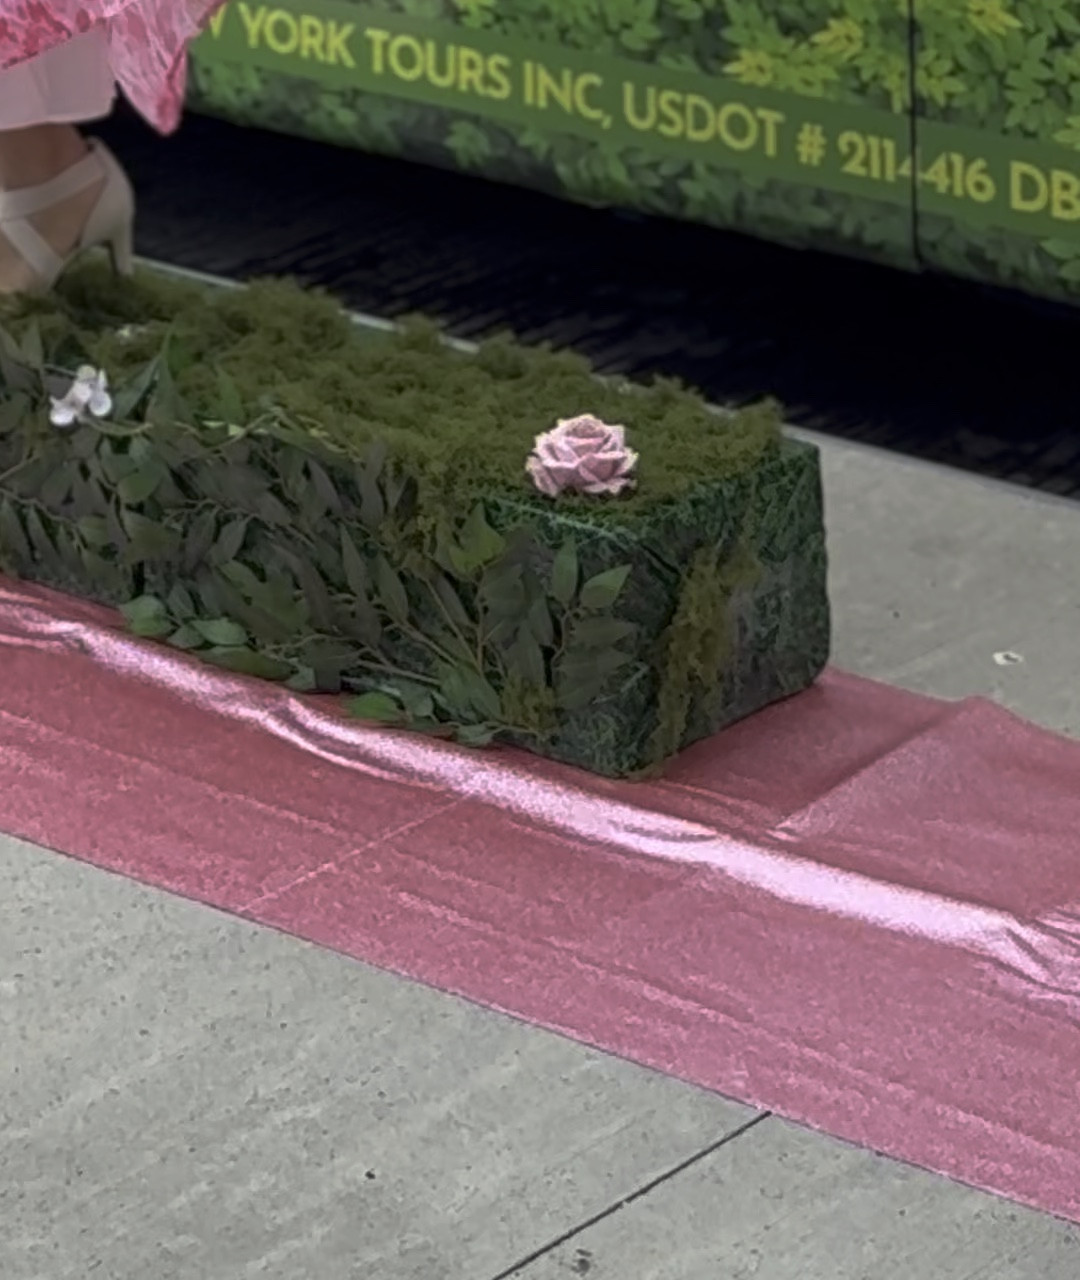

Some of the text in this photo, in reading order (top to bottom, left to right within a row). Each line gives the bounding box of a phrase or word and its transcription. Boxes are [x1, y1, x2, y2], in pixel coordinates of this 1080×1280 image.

[237, 1, 357, 69] YORK
[364, 26, 512, 100] TOURS
[522, 59, 612, 130] INC,
[622, 80, 786, 158] USDOT
[796, 122, 827, 167] #
